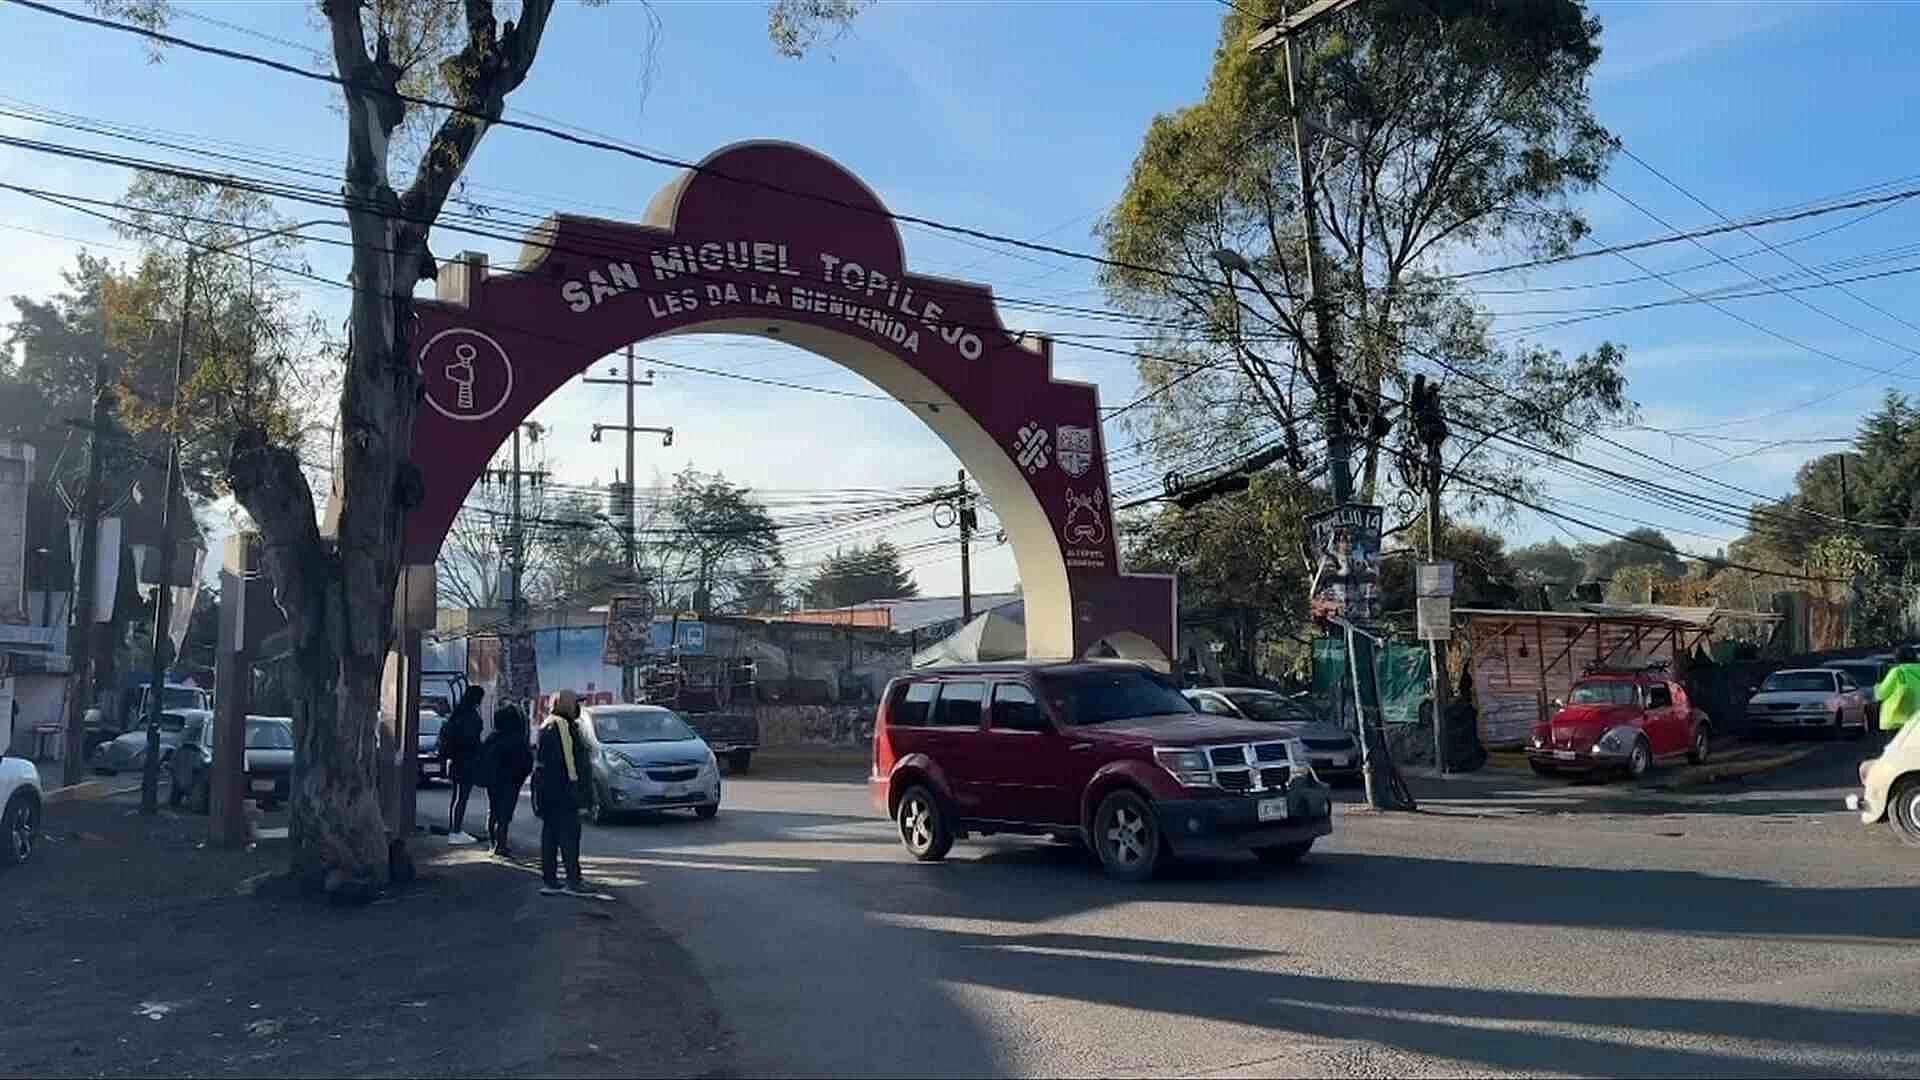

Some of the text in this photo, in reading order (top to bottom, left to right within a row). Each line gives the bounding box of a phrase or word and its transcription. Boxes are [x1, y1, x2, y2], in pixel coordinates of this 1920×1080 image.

[562, 242, 983, 360] SAN MIGUEL TOPILEJO
[648, 285, 920, 353] LES DA LA BIENVENIDA
